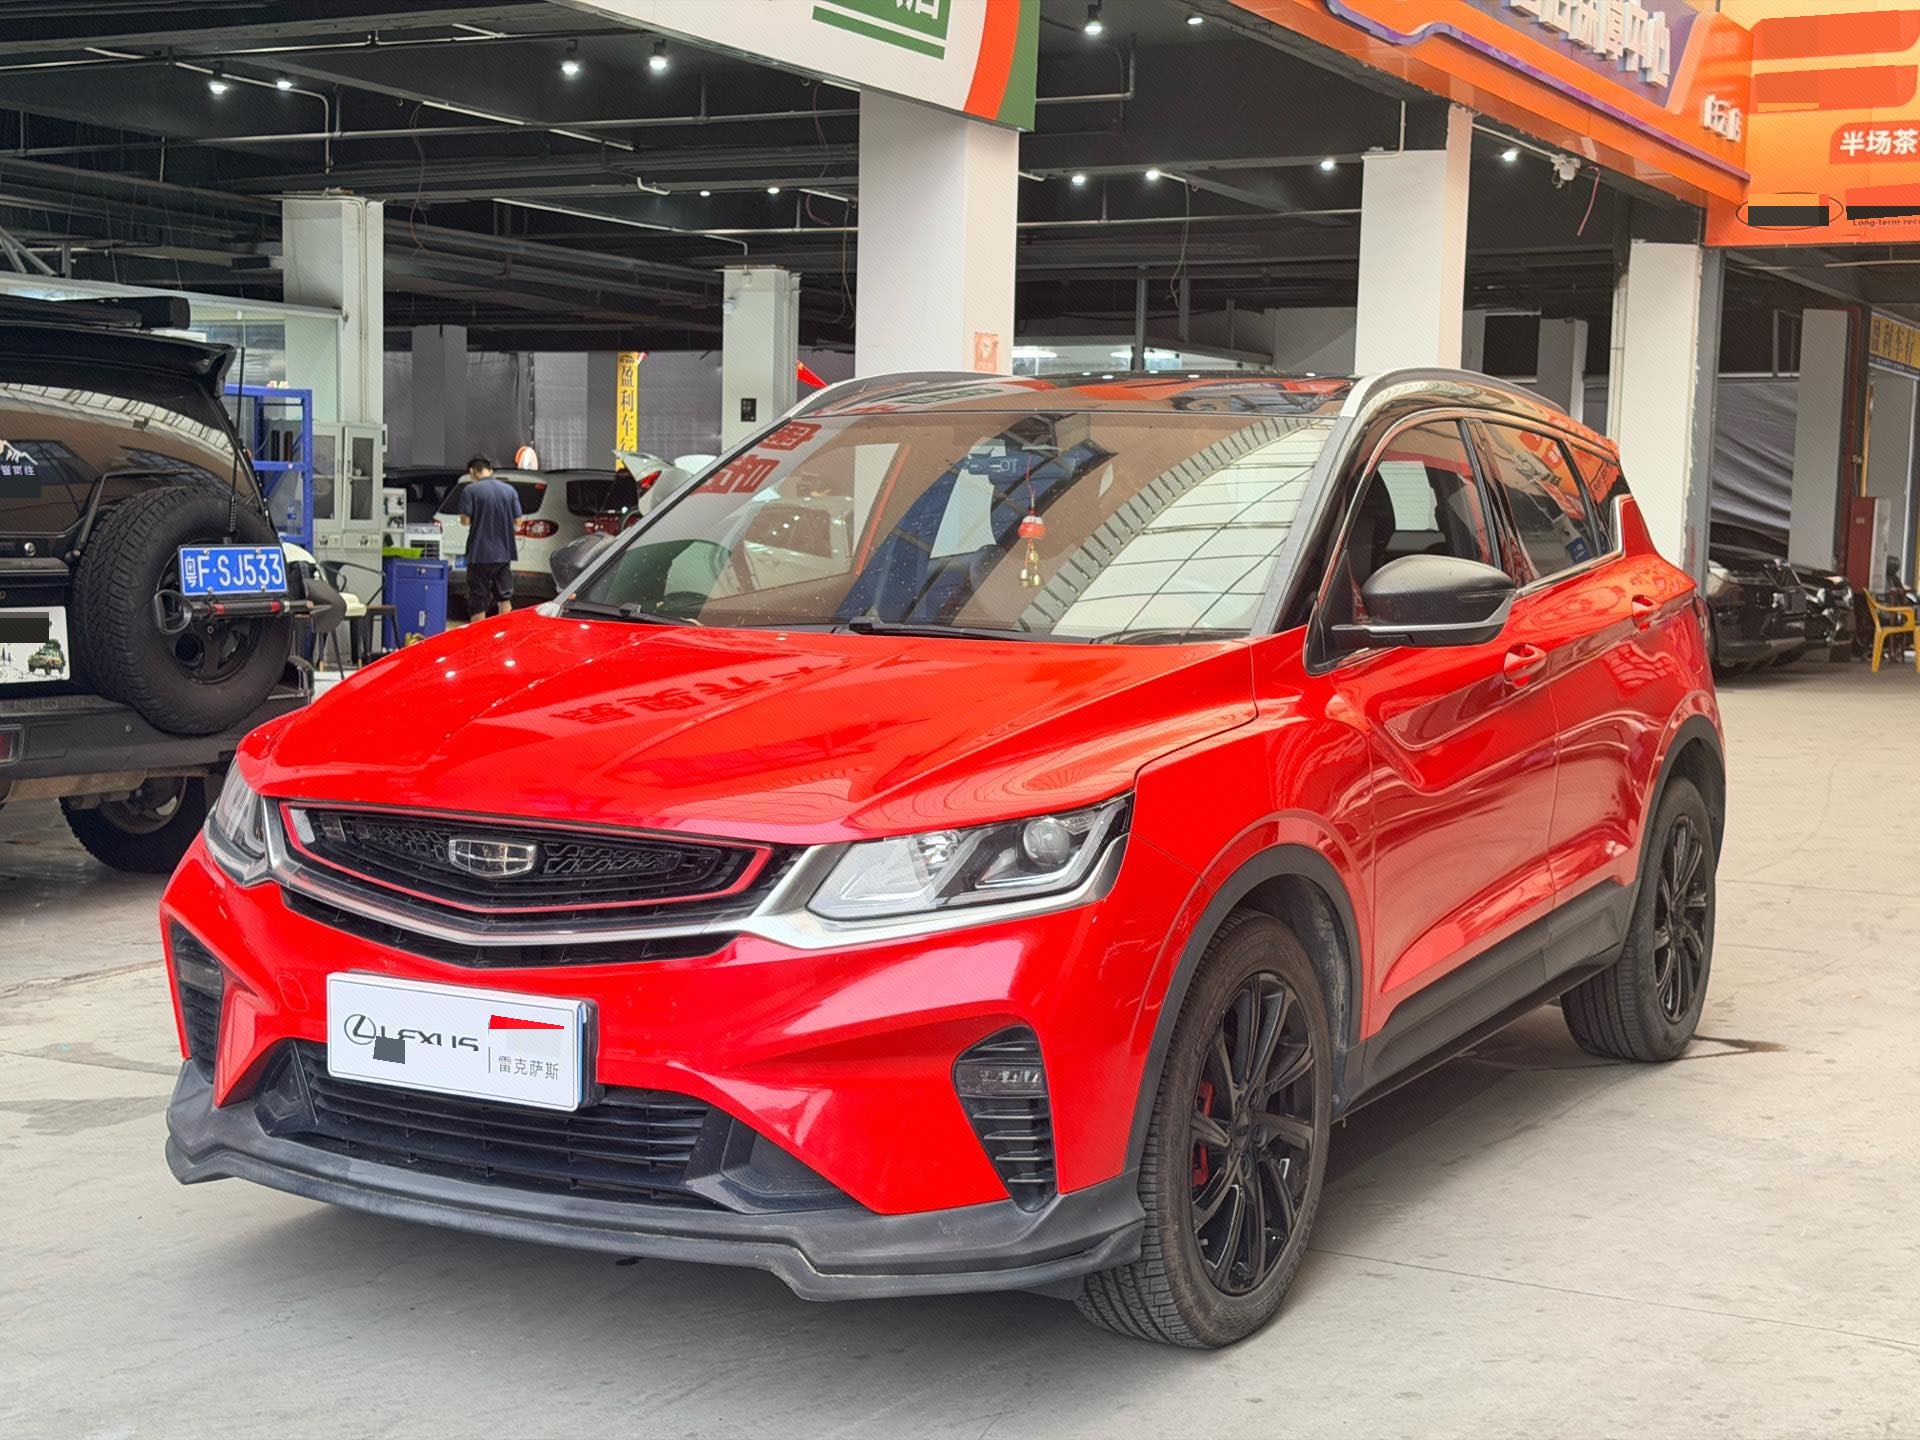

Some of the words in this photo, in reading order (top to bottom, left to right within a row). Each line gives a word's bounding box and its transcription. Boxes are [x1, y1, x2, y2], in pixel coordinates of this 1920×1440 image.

[1840, 128, 1919, 157] 半场茶
[1903, 217, 1920, 225] rec
[498, 1055, 560, 1080] 雷克萨斯
